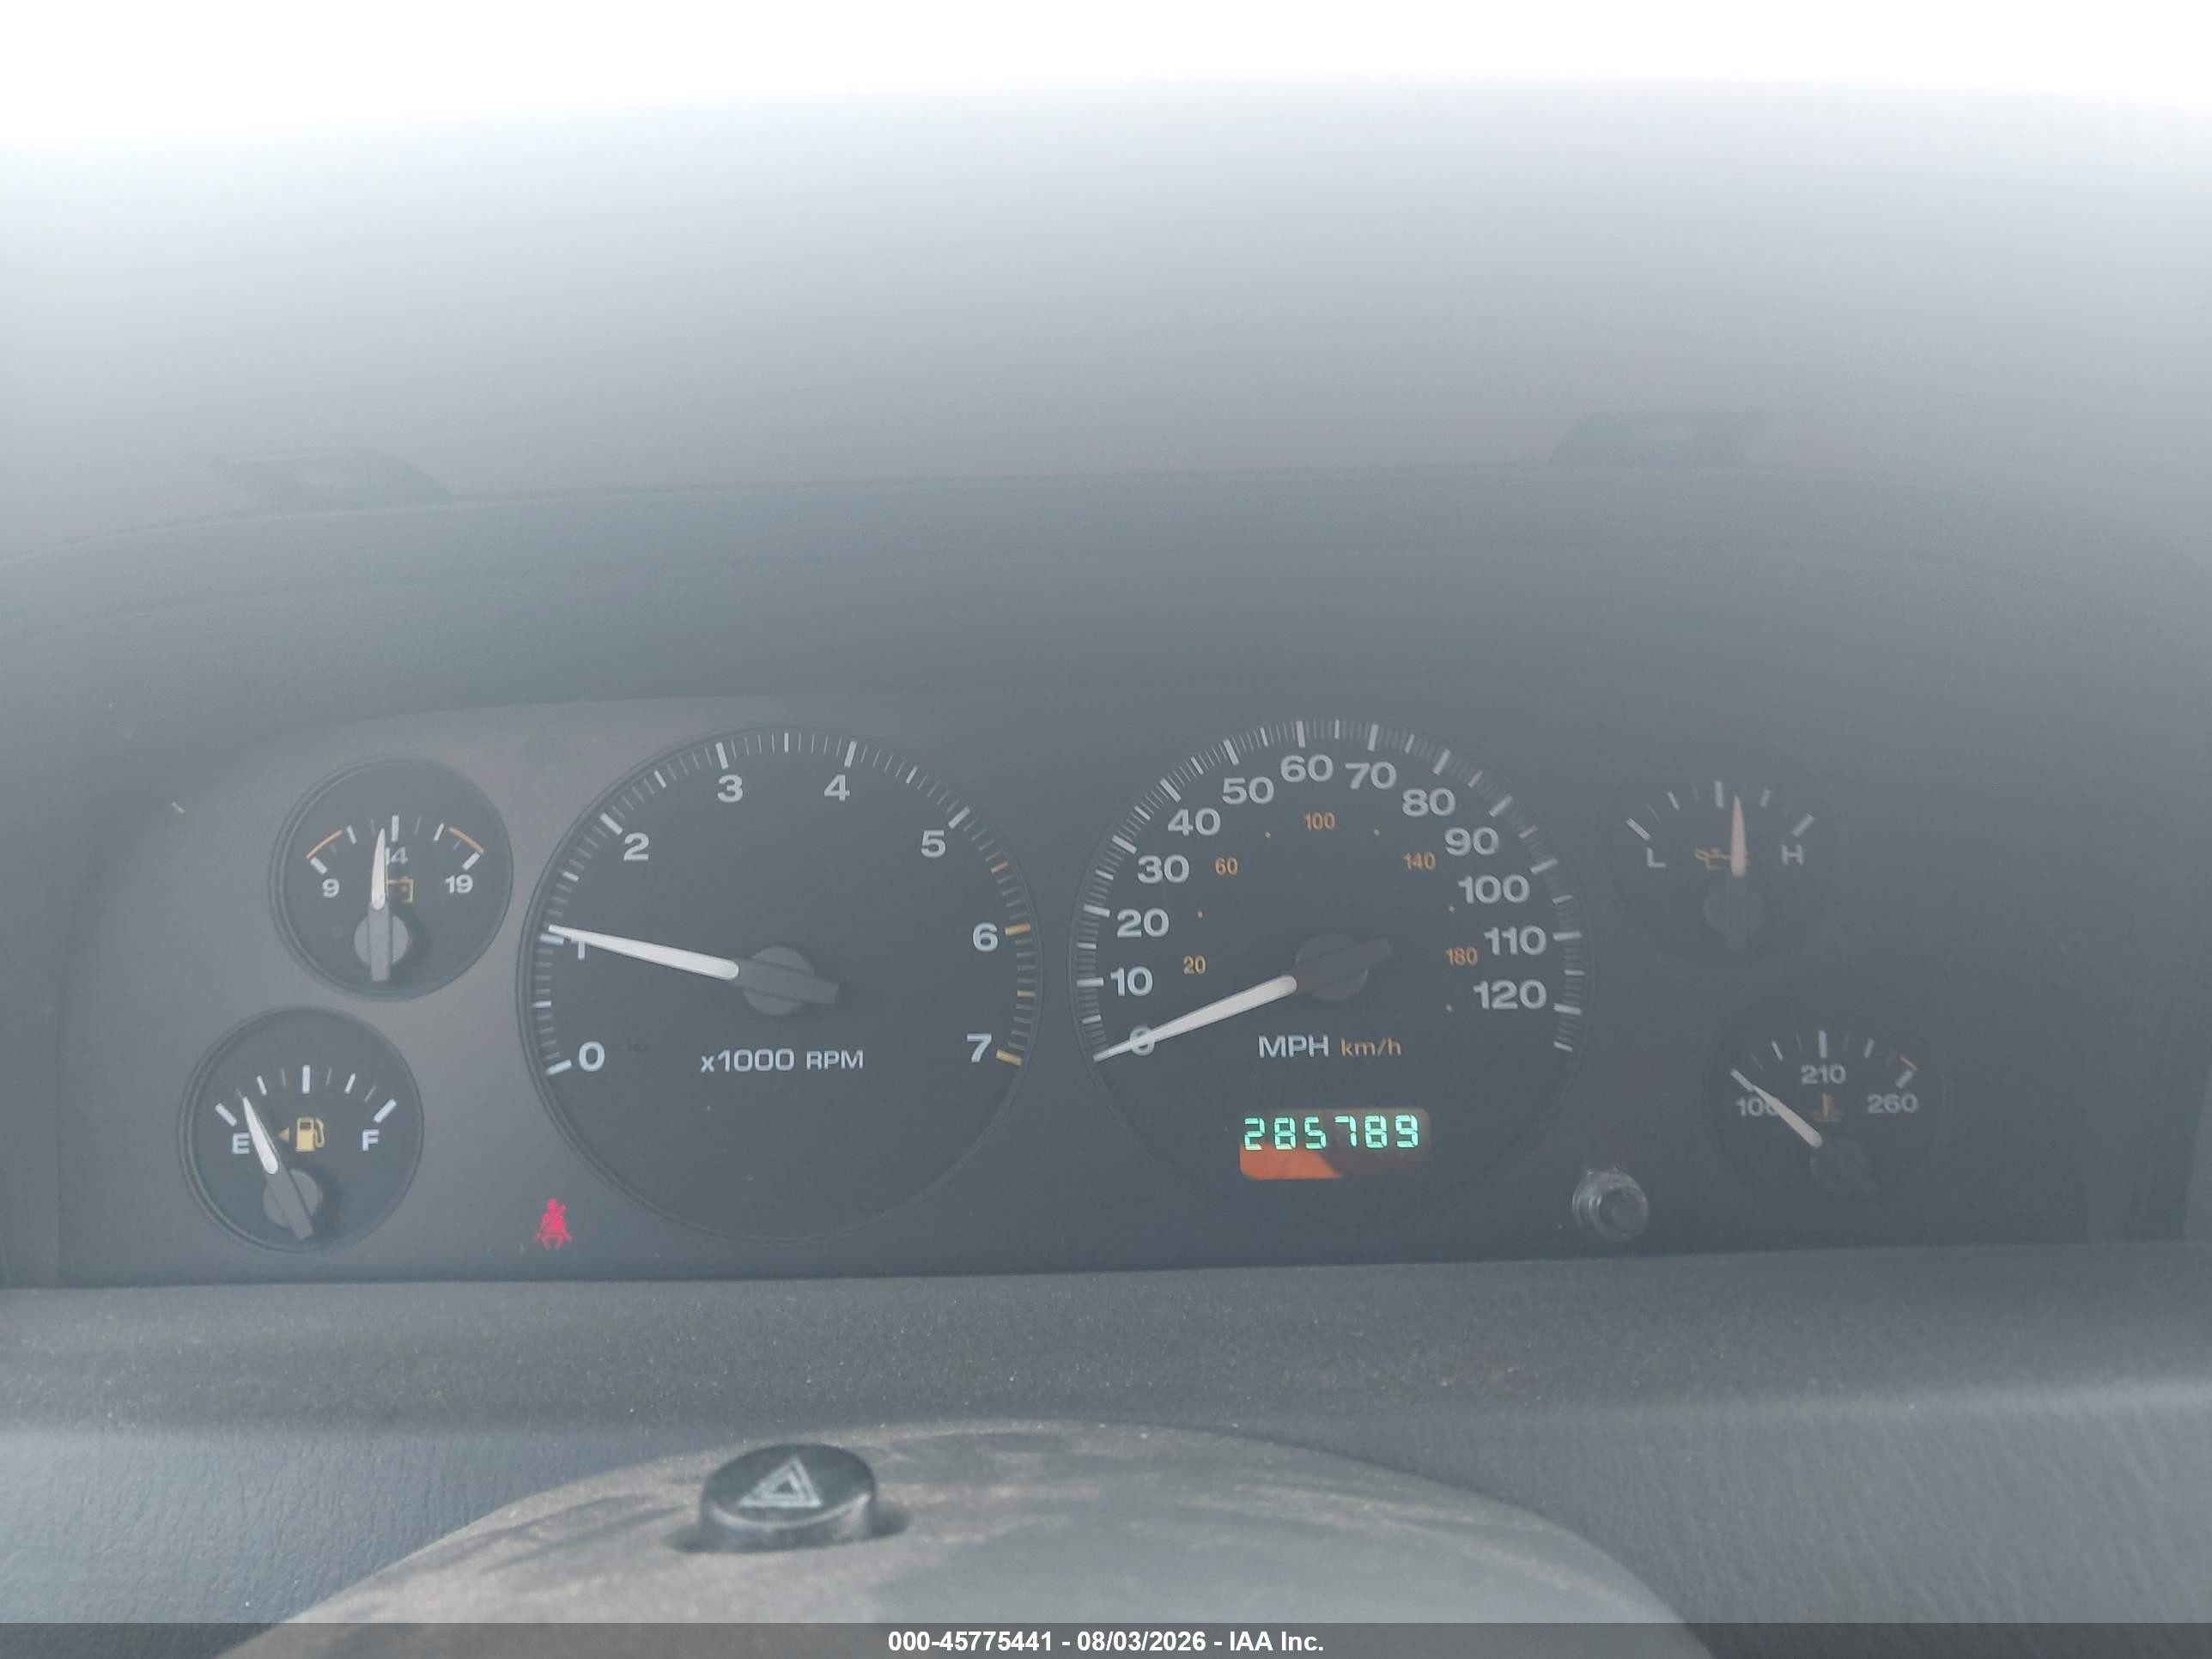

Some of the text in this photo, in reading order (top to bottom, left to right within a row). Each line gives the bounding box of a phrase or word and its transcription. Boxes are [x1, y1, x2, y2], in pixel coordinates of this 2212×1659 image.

[1280, 755, 1333, 782] 60
[1345, 762, 1397, 789] 70
[717, 775, 744, 802] 3
[823, 775, 850, 801] 4
[1222, 777, 1274, 804] 50
[1402, 788, 1455, 817] 80
[1168, 808, 1221, 836] 40
[1304, 812, 1335, 830] 100
[623, 833, 649, 860] 2
[921, 830, 945, 858] 5
[1445, 827, 1499, 854] 90
[1215, 858, 1237, 874] 60
[1404, 853, 1436, 870] 140
[1647, 848, 1666, 868] L
[1782, 844, 1803, 865] H
[1137, 856, 1189, 884] 30
[322, 878, 339, 897] 9
[445, 874, 473, 894] 19
[1458, 876, 1529, 903] 100
[1117, 908, 1169, 937] 20
[972, 923, 998, 951] 6
[1485, 927, 1547, 954] 110
[1183, 957, 1206, 974] 20
[1446, 948, 1478, 965] 180
[1110, 969, 1153, 996] 10
[1474, 981, 1547, 1009] 120
[967, 1034, 992, 1062] 7
[1129, 1025, 1155, 1055] 0
[1259, 1036, 1401, 1057] MPH km/h
[579, 1042, 605, 1072] 0
[701, 1049, 864, 1073] x1000 RPM
[1802, 1066, 1846, 1085] 210
[1868, 1094, 1917, 1113] 260
[233, 1134, 250, 1154] E
[362, 1130, 379, 1151] F
[1244, 1115, 1419, 1151] 285789
